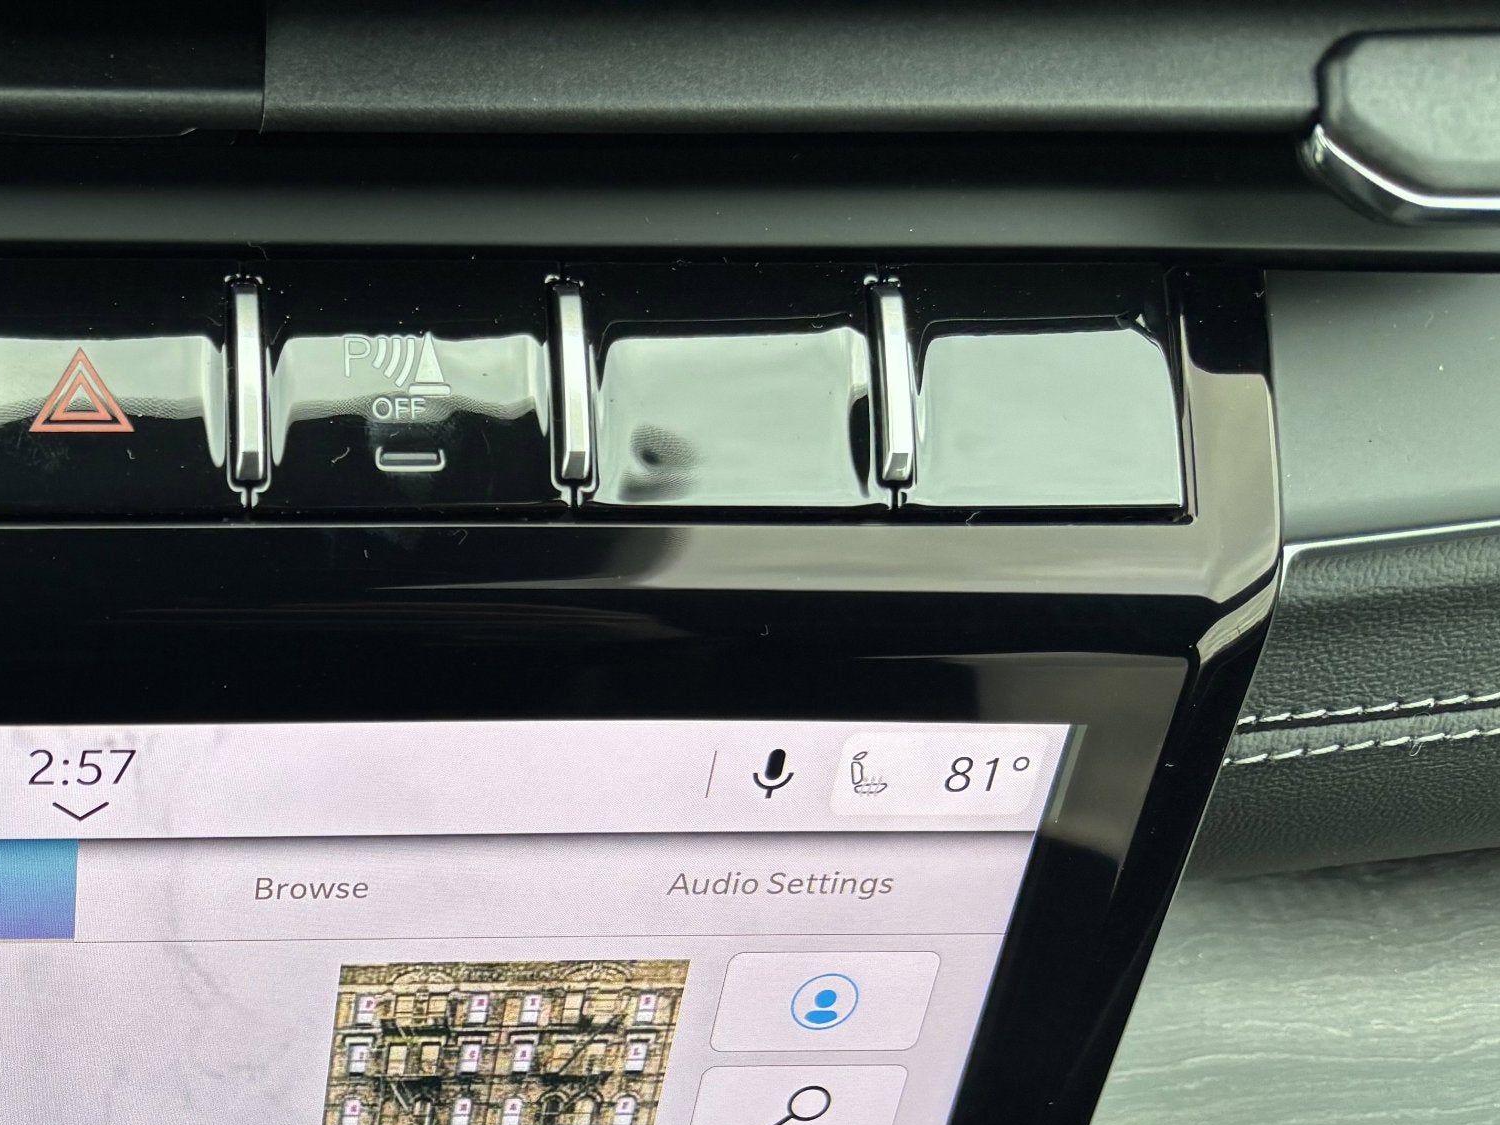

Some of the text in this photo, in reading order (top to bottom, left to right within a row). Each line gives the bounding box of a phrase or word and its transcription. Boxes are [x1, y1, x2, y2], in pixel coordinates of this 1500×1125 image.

[371, 396, 426, 420] OFF
[27, 748, 138, 787] 2:57
[943, 754, 1032, 794] 81°
[253, 875, 370, 902] Browse
[666, 870, 896, 901] Audio Settings
